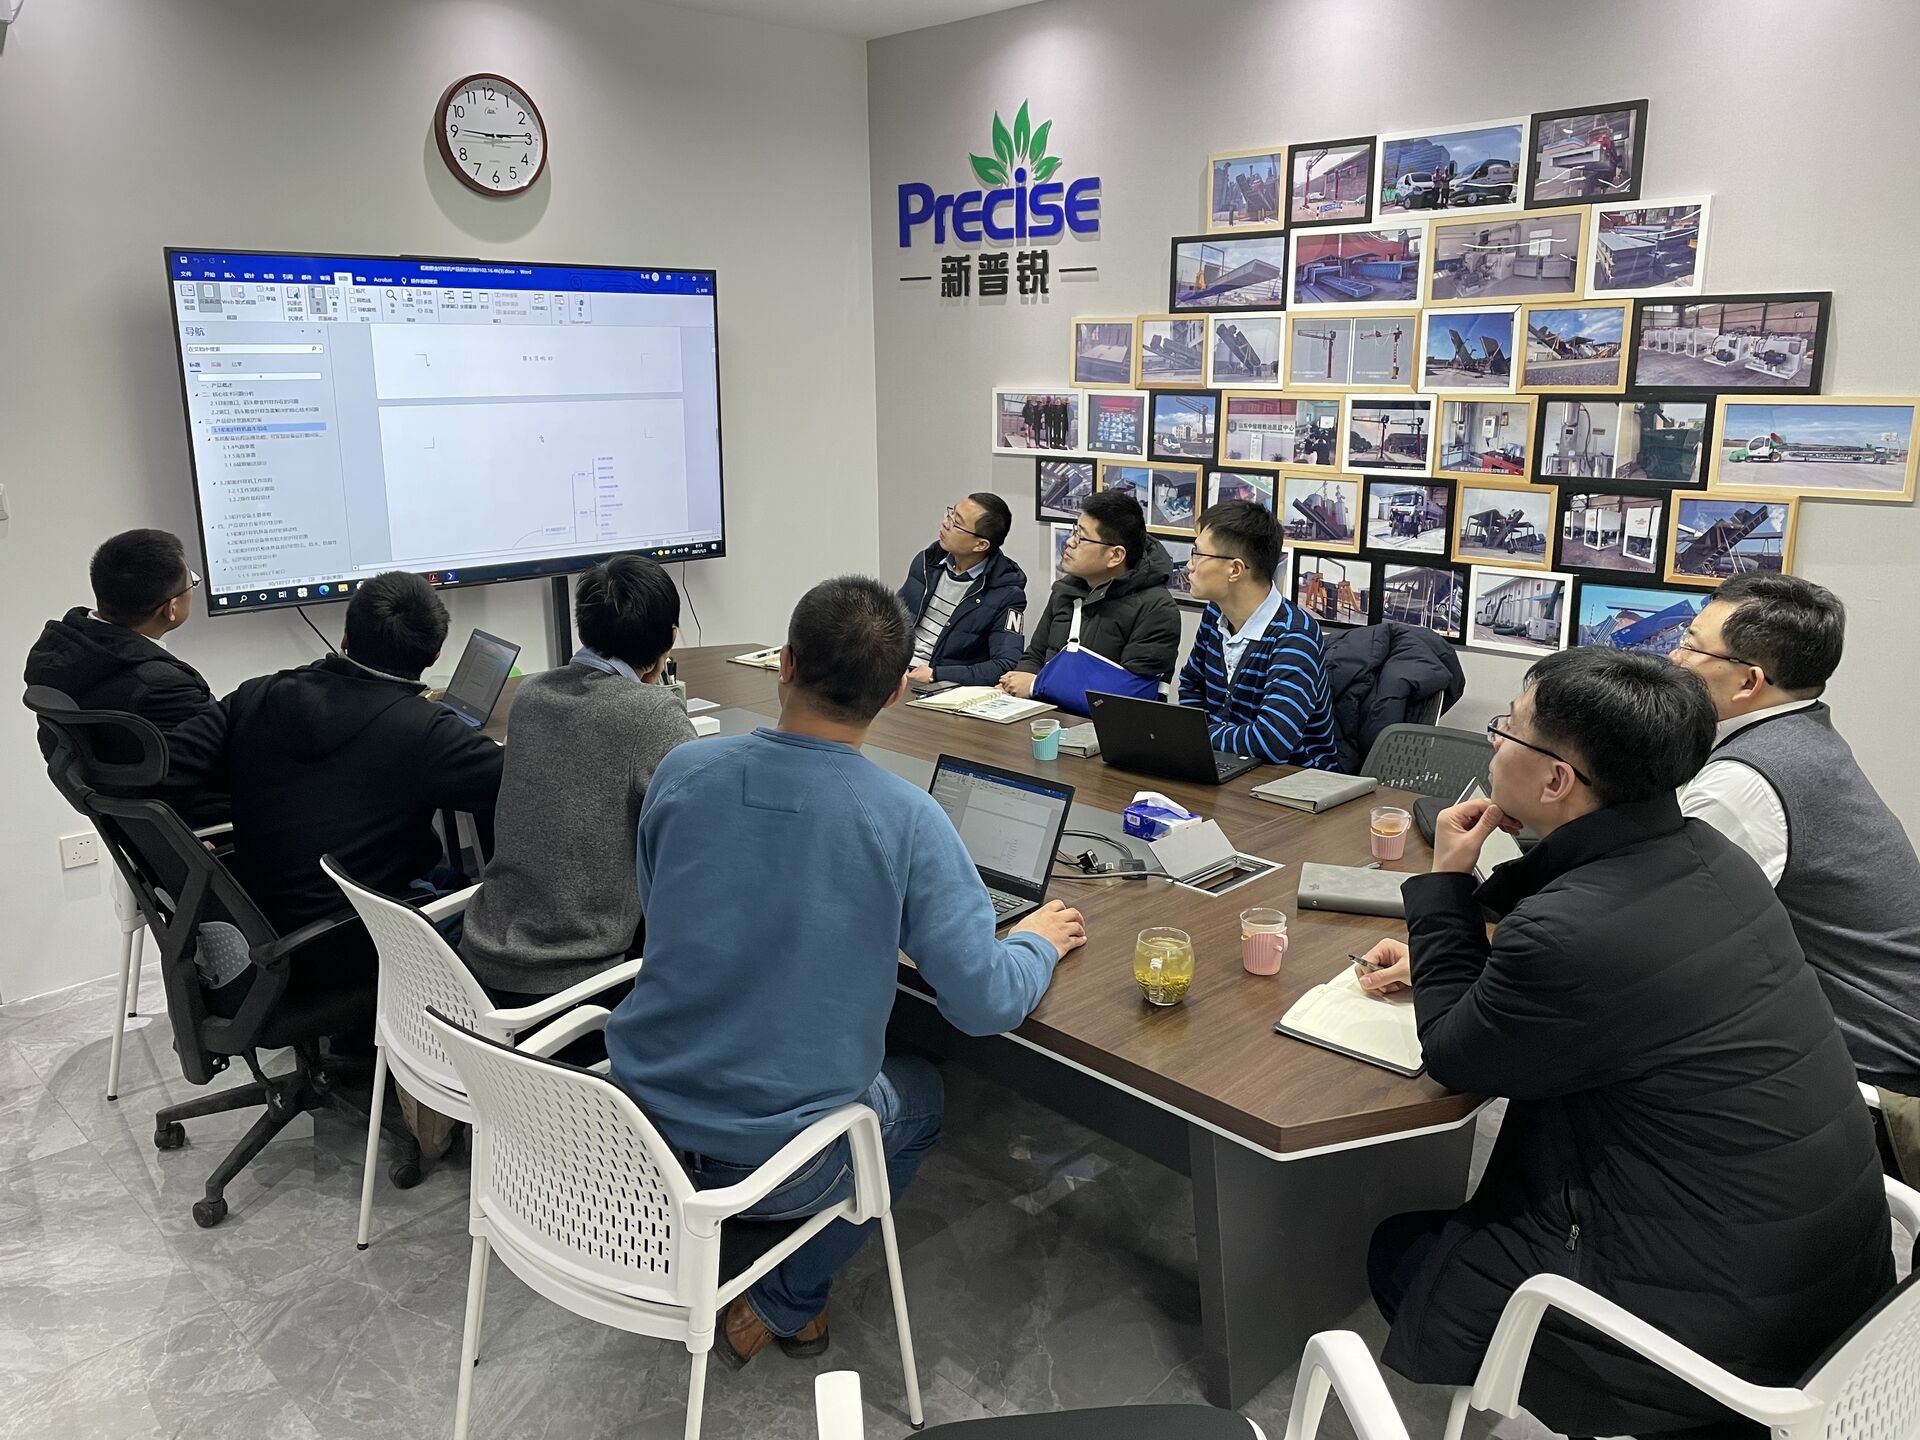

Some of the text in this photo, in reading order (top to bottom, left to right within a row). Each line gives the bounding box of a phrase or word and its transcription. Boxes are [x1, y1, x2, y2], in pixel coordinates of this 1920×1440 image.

[465, 91, 477, 105] 11
[482, 87, 495, 101] 12
[504, 95, 509, 108] 1
[453, 104, 465, 119] 10
[517, 111, 526, 125] 2
[450, 124, 459, 138] 9
[524, 132, 533, 146] 3
[459, 147, 468, 161] 8
[520, 153, 529, 166] 4
[473, 162, 482, 176] 7
[509, 166, 517, 180] 5
[492, 170, 500, 184] 6
[940, 249, 1050, 298] 新普锐
[185, 326, 206, 337] 导航
[1006, 610, 1022, 633] N
